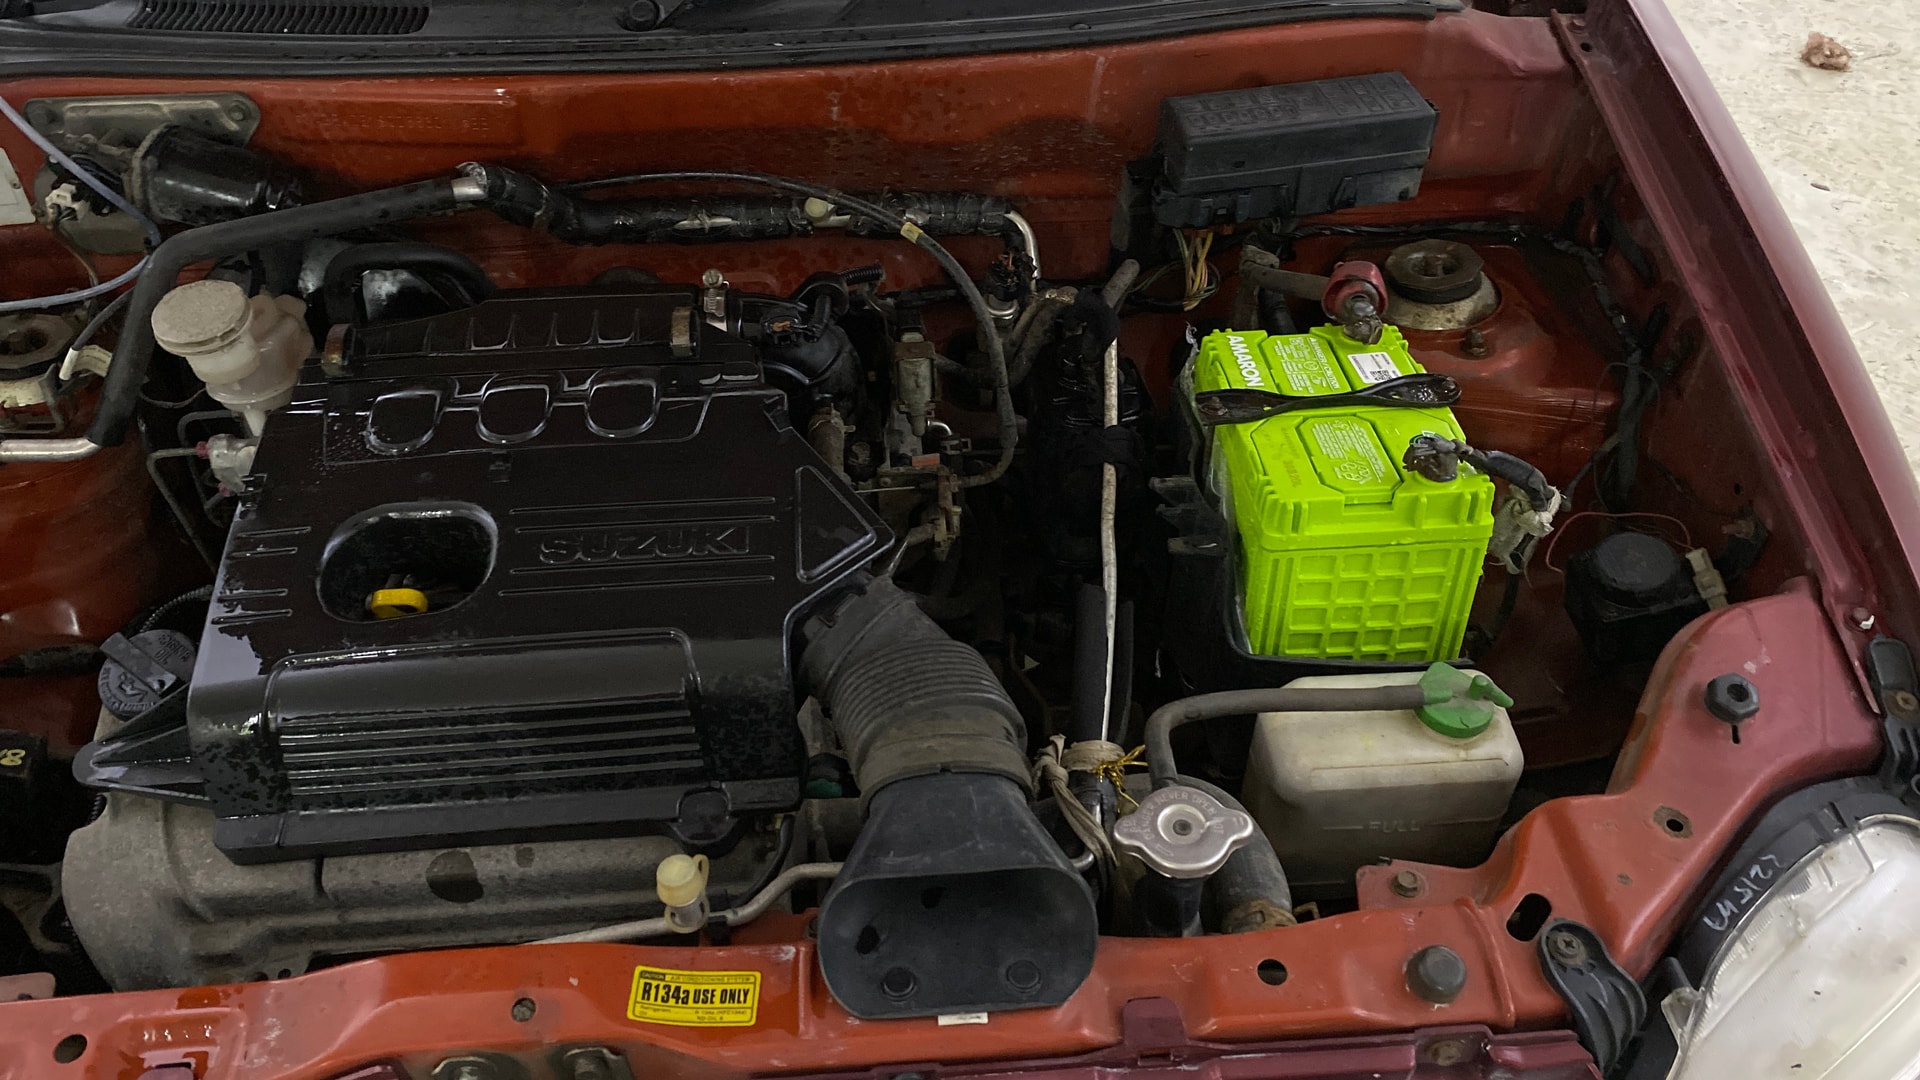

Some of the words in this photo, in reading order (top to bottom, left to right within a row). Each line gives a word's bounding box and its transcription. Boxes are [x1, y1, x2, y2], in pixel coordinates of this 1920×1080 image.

[1225, 334, 1265, 388] AMARON
[540, 527, 749, 564] SUZUKI
[1369, 820, 1420, 833] FULL
[641, 981, 690, 1005] R134a
[693, 988, 717, 1004] USE
[719, 988, 750, 1004] ONLY
